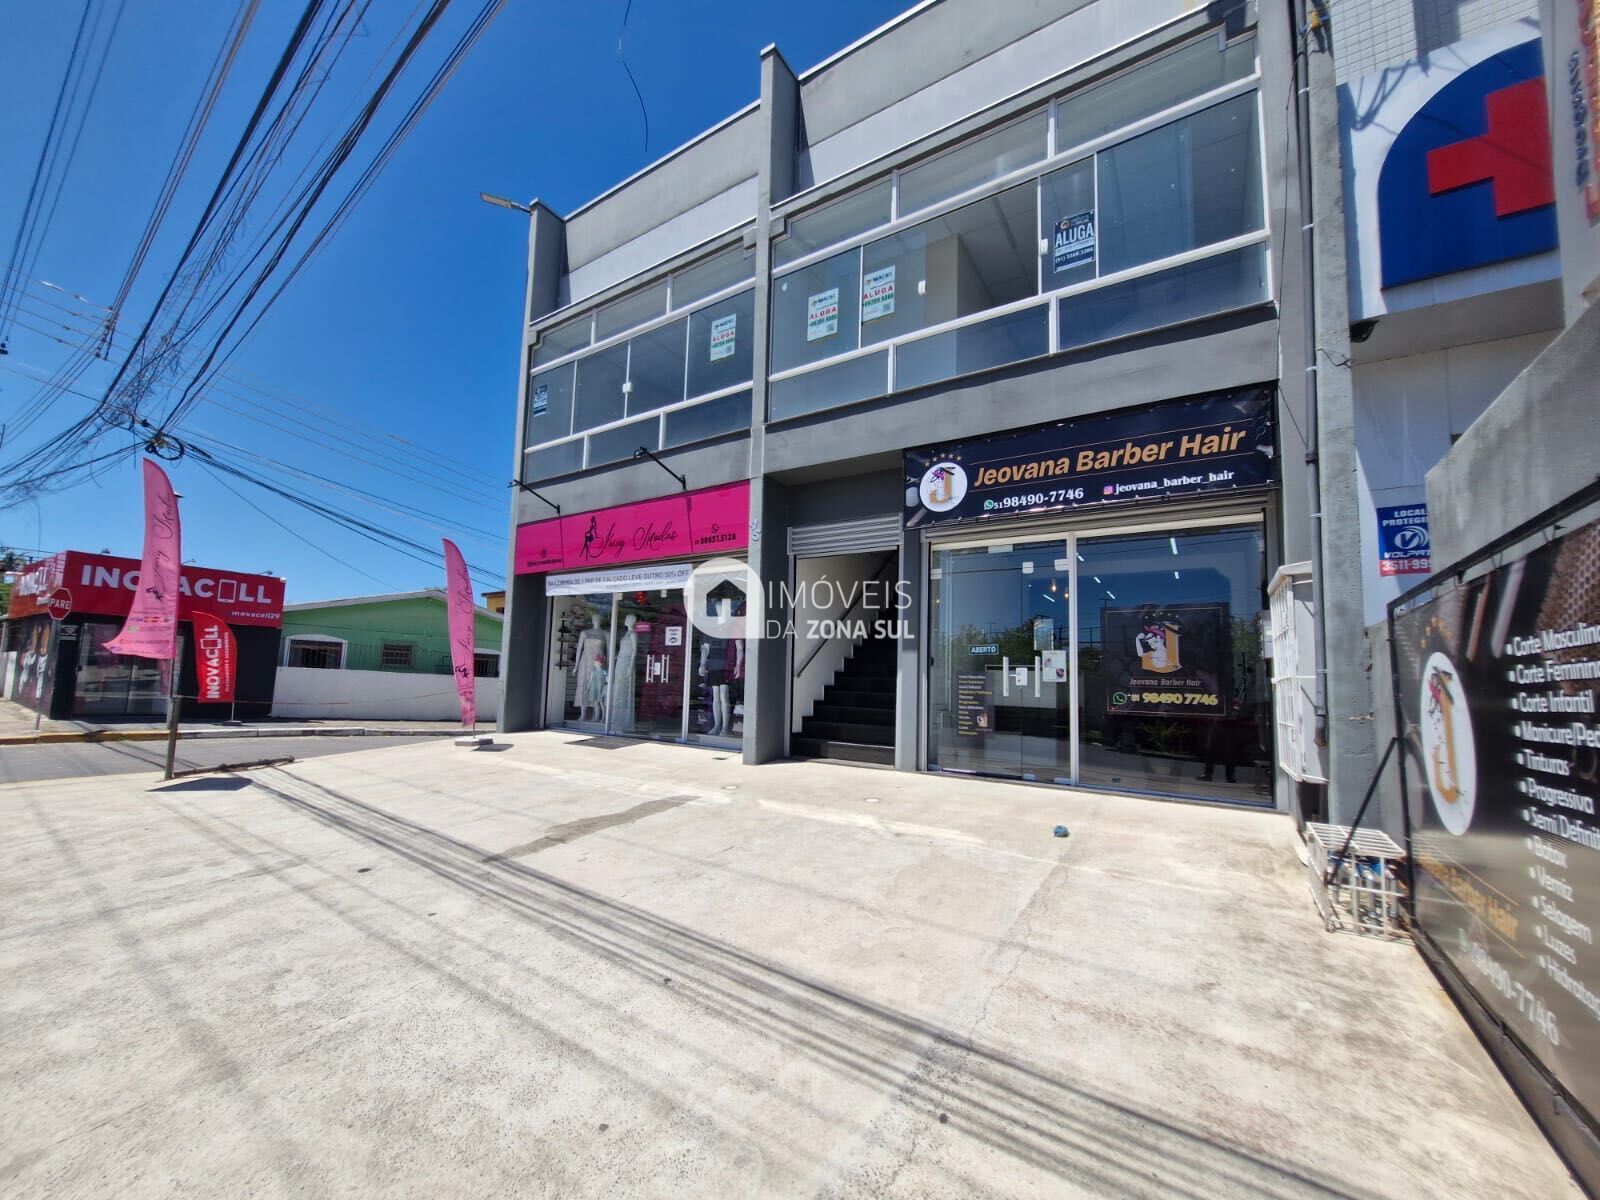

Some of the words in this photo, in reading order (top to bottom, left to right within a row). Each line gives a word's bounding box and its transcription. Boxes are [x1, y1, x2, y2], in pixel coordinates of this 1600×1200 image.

[1055, 222, 1094, 248] ALUGA
[863, 285, 894, 300] ALUGA
[810, 306, 837, 320] ALUGA
[974, 457, 1070, 488] Jeovana
[1075, 441, 1174, 473] Barber
[1179, 426, 1247, 458] Hair
[1114, 470, 1235, 495] jeovana_barber_hair
[1394, 508, 1427, 518] LOCAL
[678, 569, 689, 577] OFF
[50, 598, 71, 609] PARE
[970, 645, 997, 654] ABERTO
[1514, 636, 1542, 657] Corte
[1130, 678, 1158, 686] Jeovana
[1160, 678, 1185, 686] Barber
[1186, 678, 1201, 686] Hair
[1516, 664, 1545, 684] Corte
[1518, 692, 1548, 713] Corte
[1549, 690, 1596, 713] Infantil
[1522, 748, 1570, 776] Tinturas
[1526, 777, 1595, 815] Progressiva
[1530, 806, 1558, 836] Semi
[1532, 835, 1568, 868] Botox
[1536, 864, 1575, 902] Verniz
[1488, 896, 1520, 941] Hair
[1541, 896, 1593, 945] Selagem
[1544, 924, 1577, 965] Luzes
